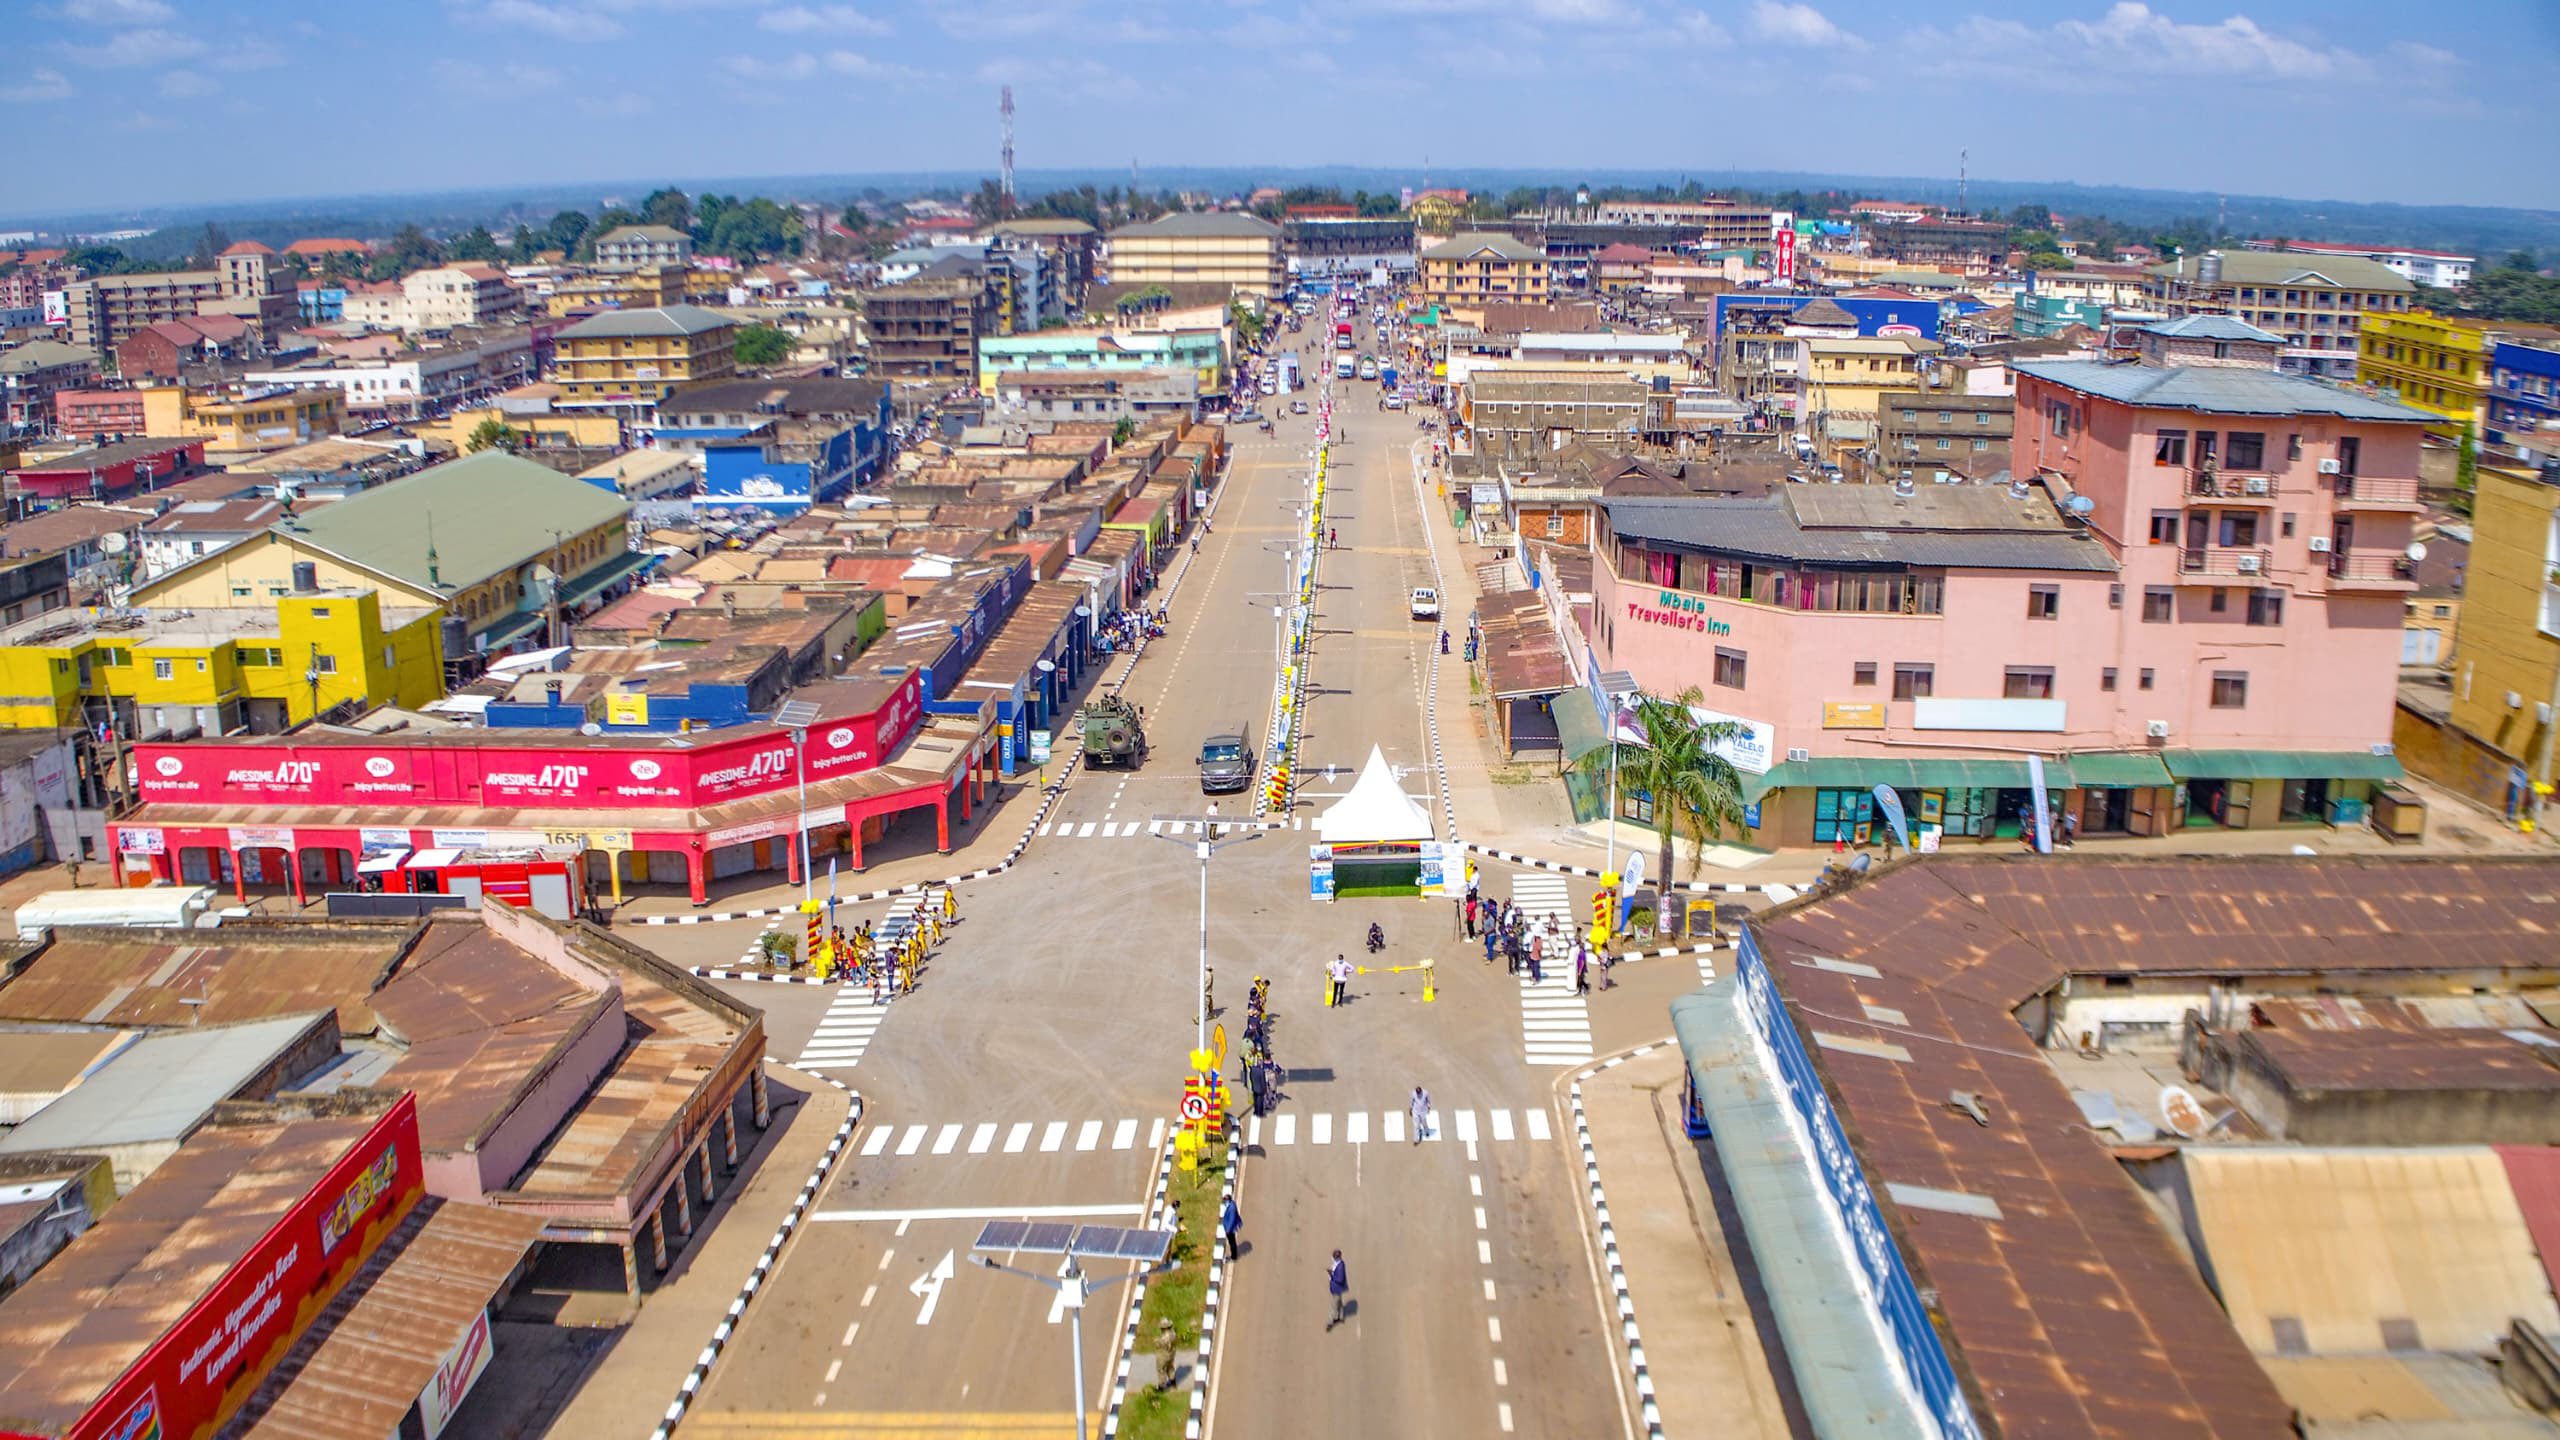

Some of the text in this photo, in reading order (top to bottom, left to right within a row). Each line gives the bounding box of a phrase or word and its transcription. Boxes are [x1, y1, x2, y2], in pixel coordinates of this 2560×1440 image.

[1660, 591, 1705, 614] Mbale
[1628, 603, 1730, 637] Traveller's Inn
[227, 770, 274, 783] AWESOME
[275, 762, 312, 783] A70
[486, 773, 537, 787] AWESOME
[538, 765, 579, 788] A70
[698, 766, 748, 787] AWESOME
[749, 750, 785, 777] A70
[225, 1271, 274, 1335] Uganda's
[275, 1242, 298, 1281] Best
[207, 1332, 240, 1385] Loved
